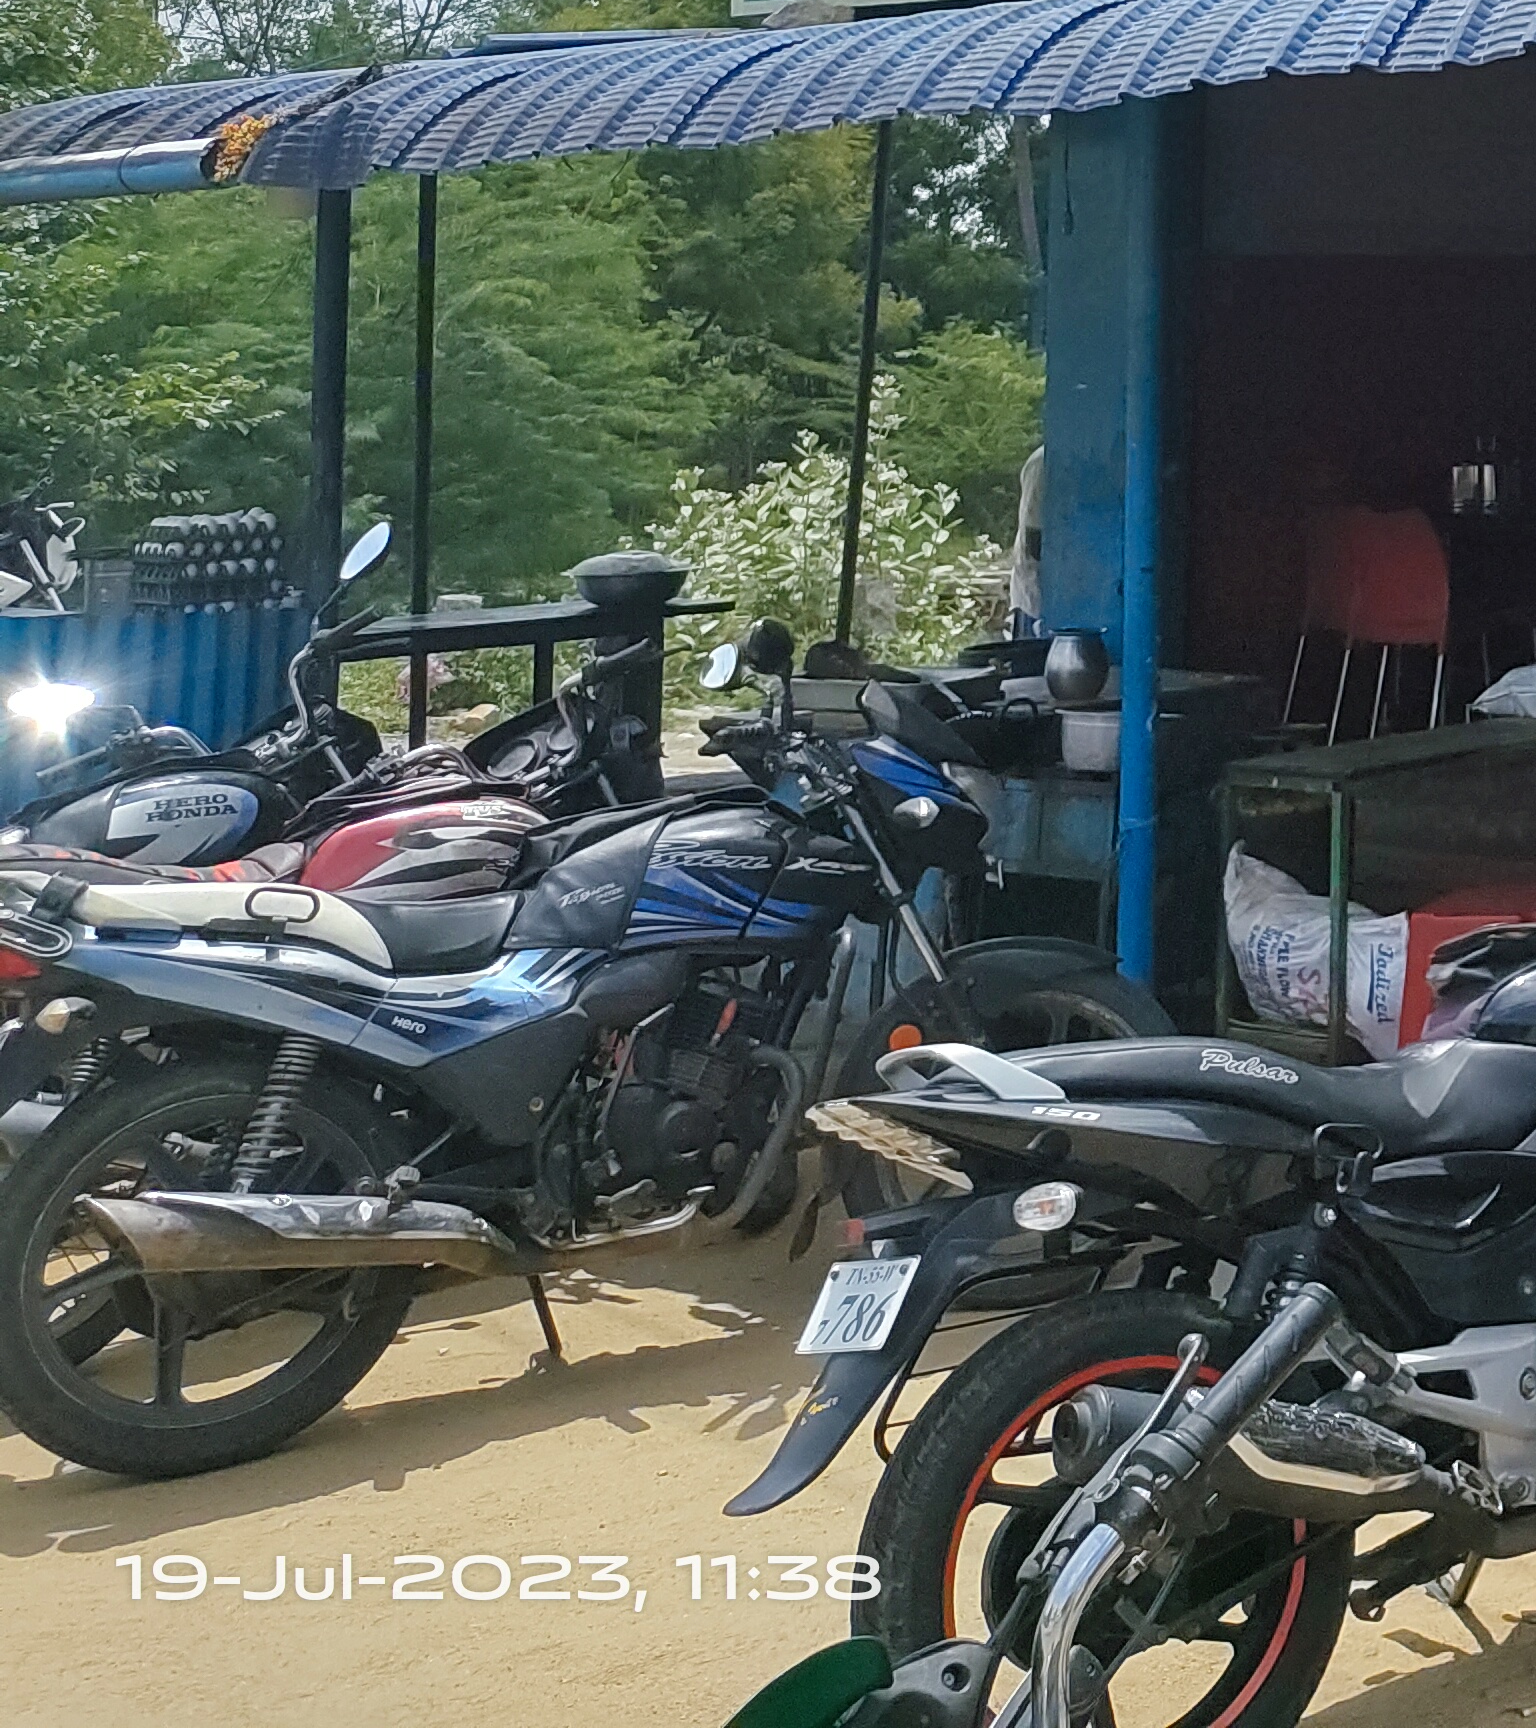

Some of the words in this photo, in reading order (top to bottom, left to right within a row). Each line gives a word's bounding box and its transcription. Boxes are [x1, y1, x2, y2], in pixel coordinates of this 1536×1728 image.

[153, 793, 228, 810] HERO
[145, 804, 239, 822] HONDA
[1200, 1048, 1299, 1084] Pulsar
[1031, 1105, 1100, 1121] 150
